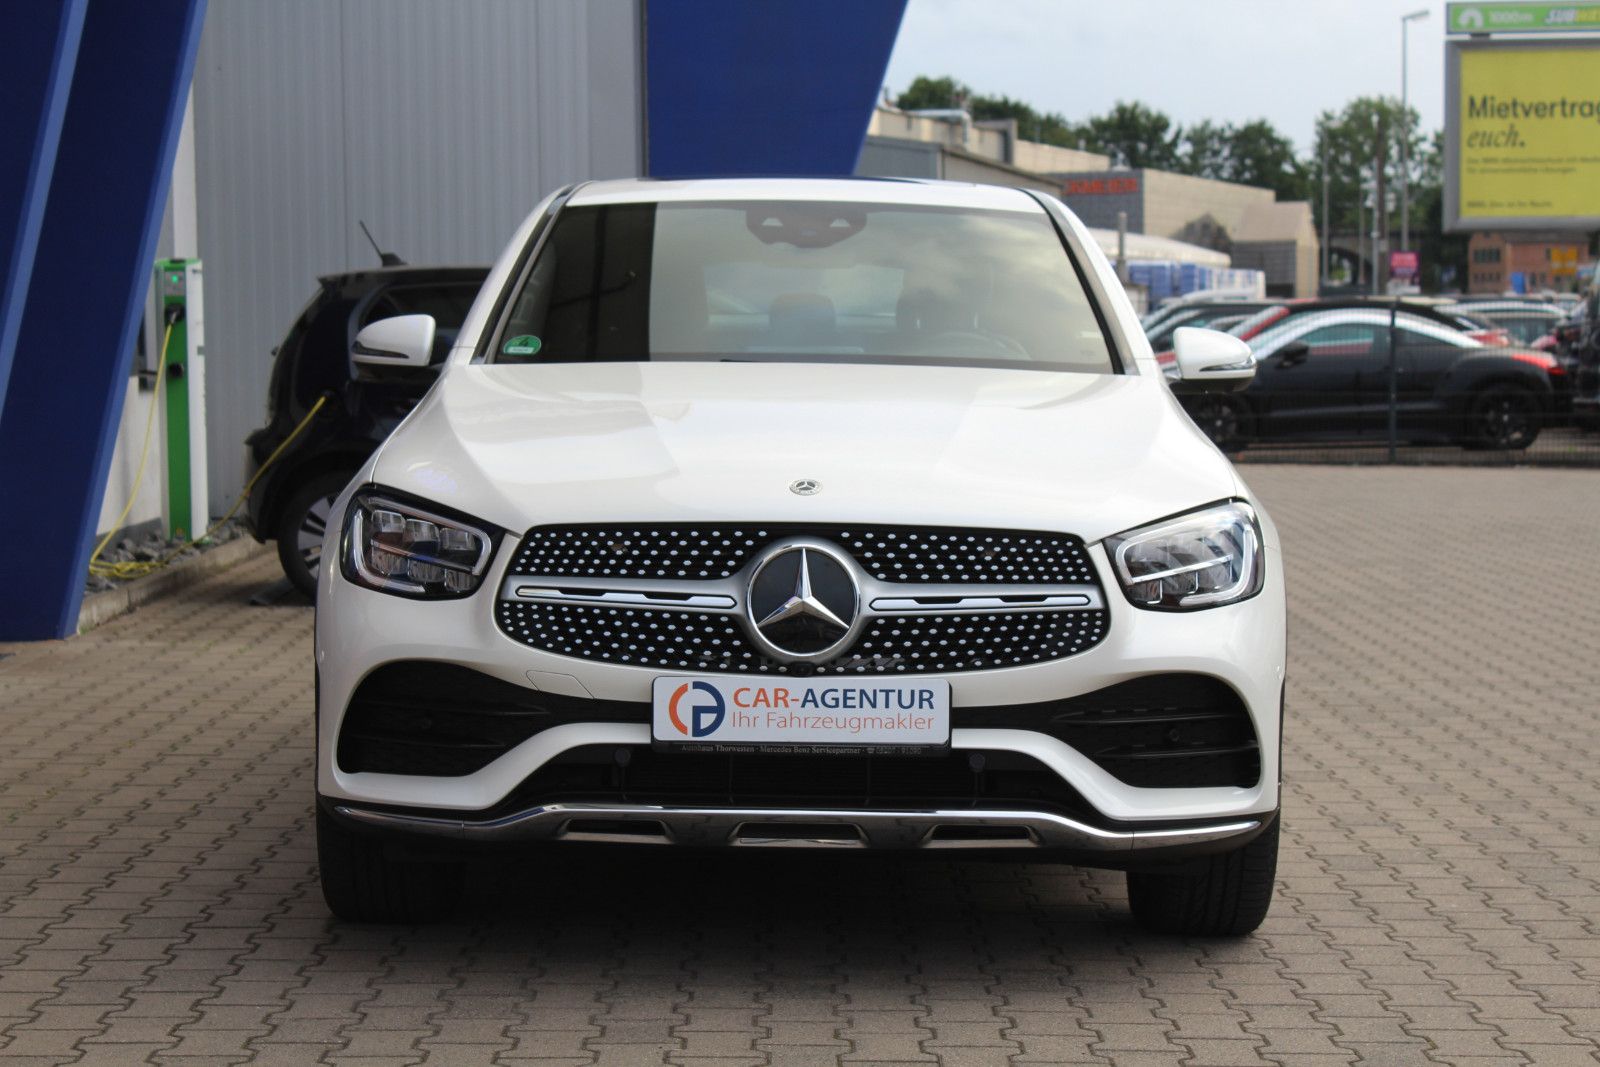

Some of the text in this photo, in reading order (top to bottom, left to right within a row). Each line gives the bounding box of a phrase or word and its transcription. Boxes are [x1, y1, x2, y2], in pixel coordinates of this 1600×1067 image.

[1467, 124, 1526, 148] euch.
[733, 687, 935, 710] CAR-AGENTUR
[732, 711, 935, 733] Ihr Fahrzeugmakler
